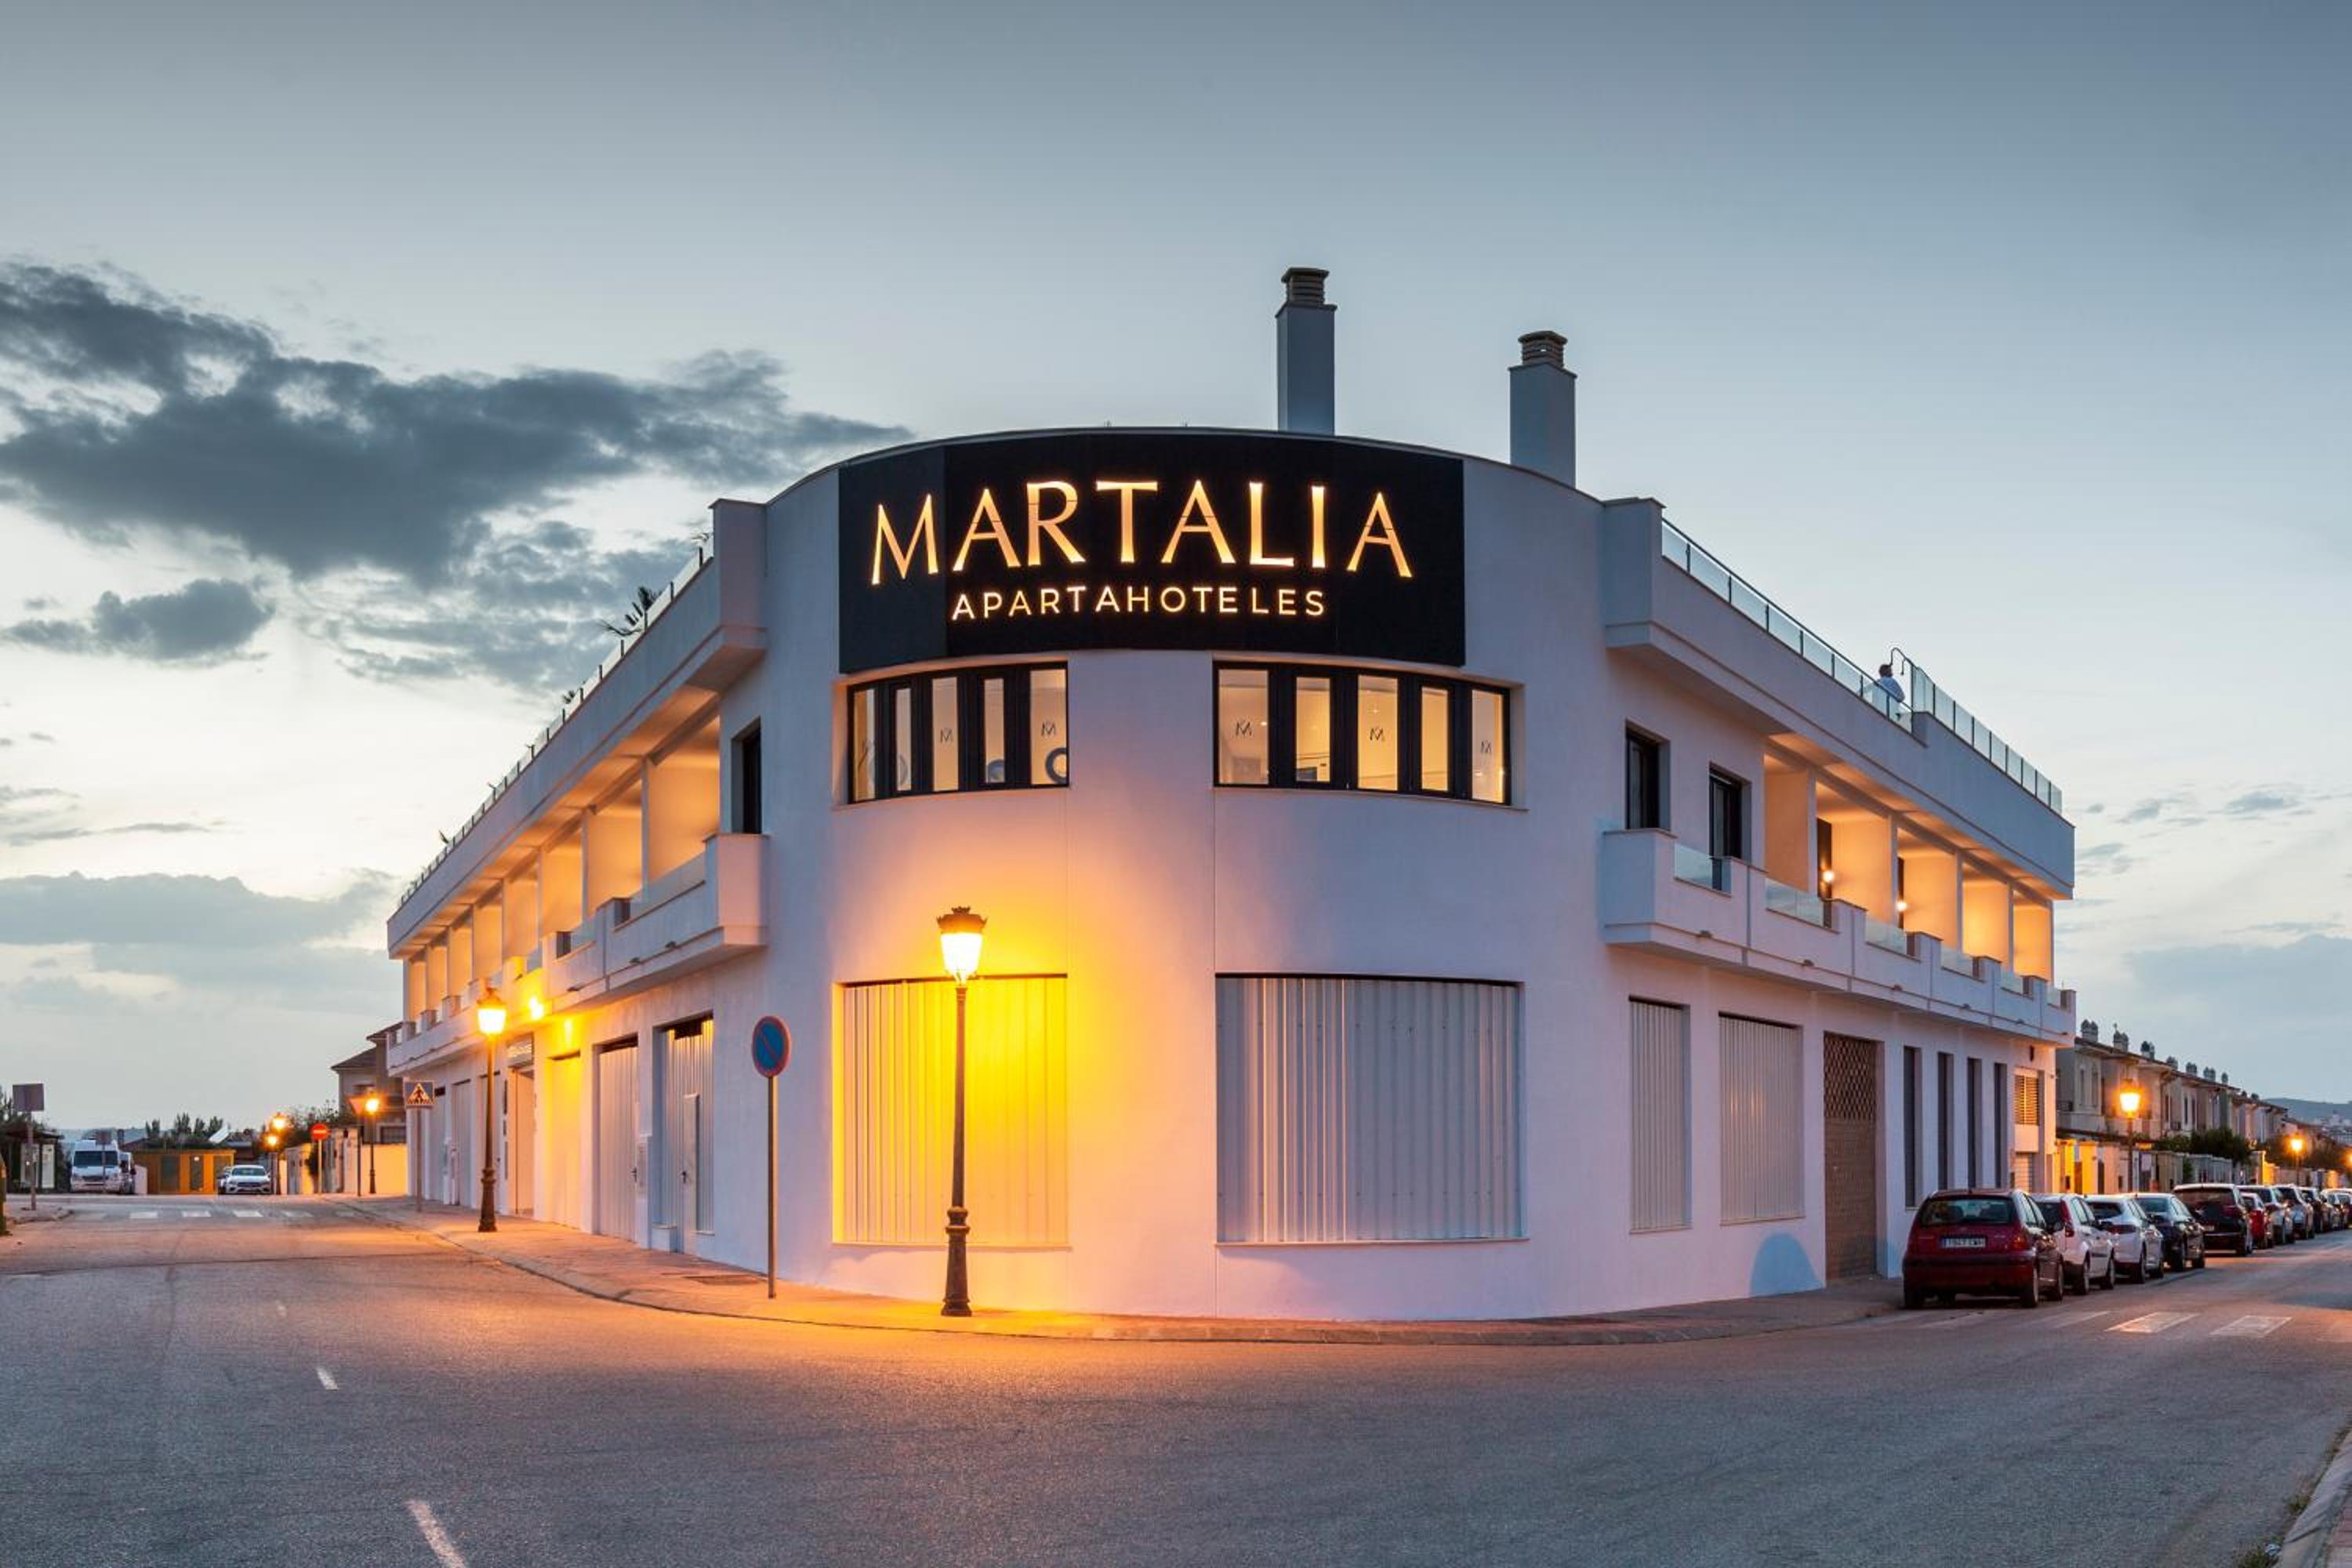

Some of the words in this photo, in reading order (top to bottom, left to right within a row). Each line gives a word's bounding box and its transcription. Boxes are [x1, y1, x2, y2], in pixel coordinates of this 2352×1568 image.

[871, 479, 1413, 586] MARTALIA
[951, 584, 1325, 621] APARTAHOTELES
[1040, 721, 1057, 736] M
